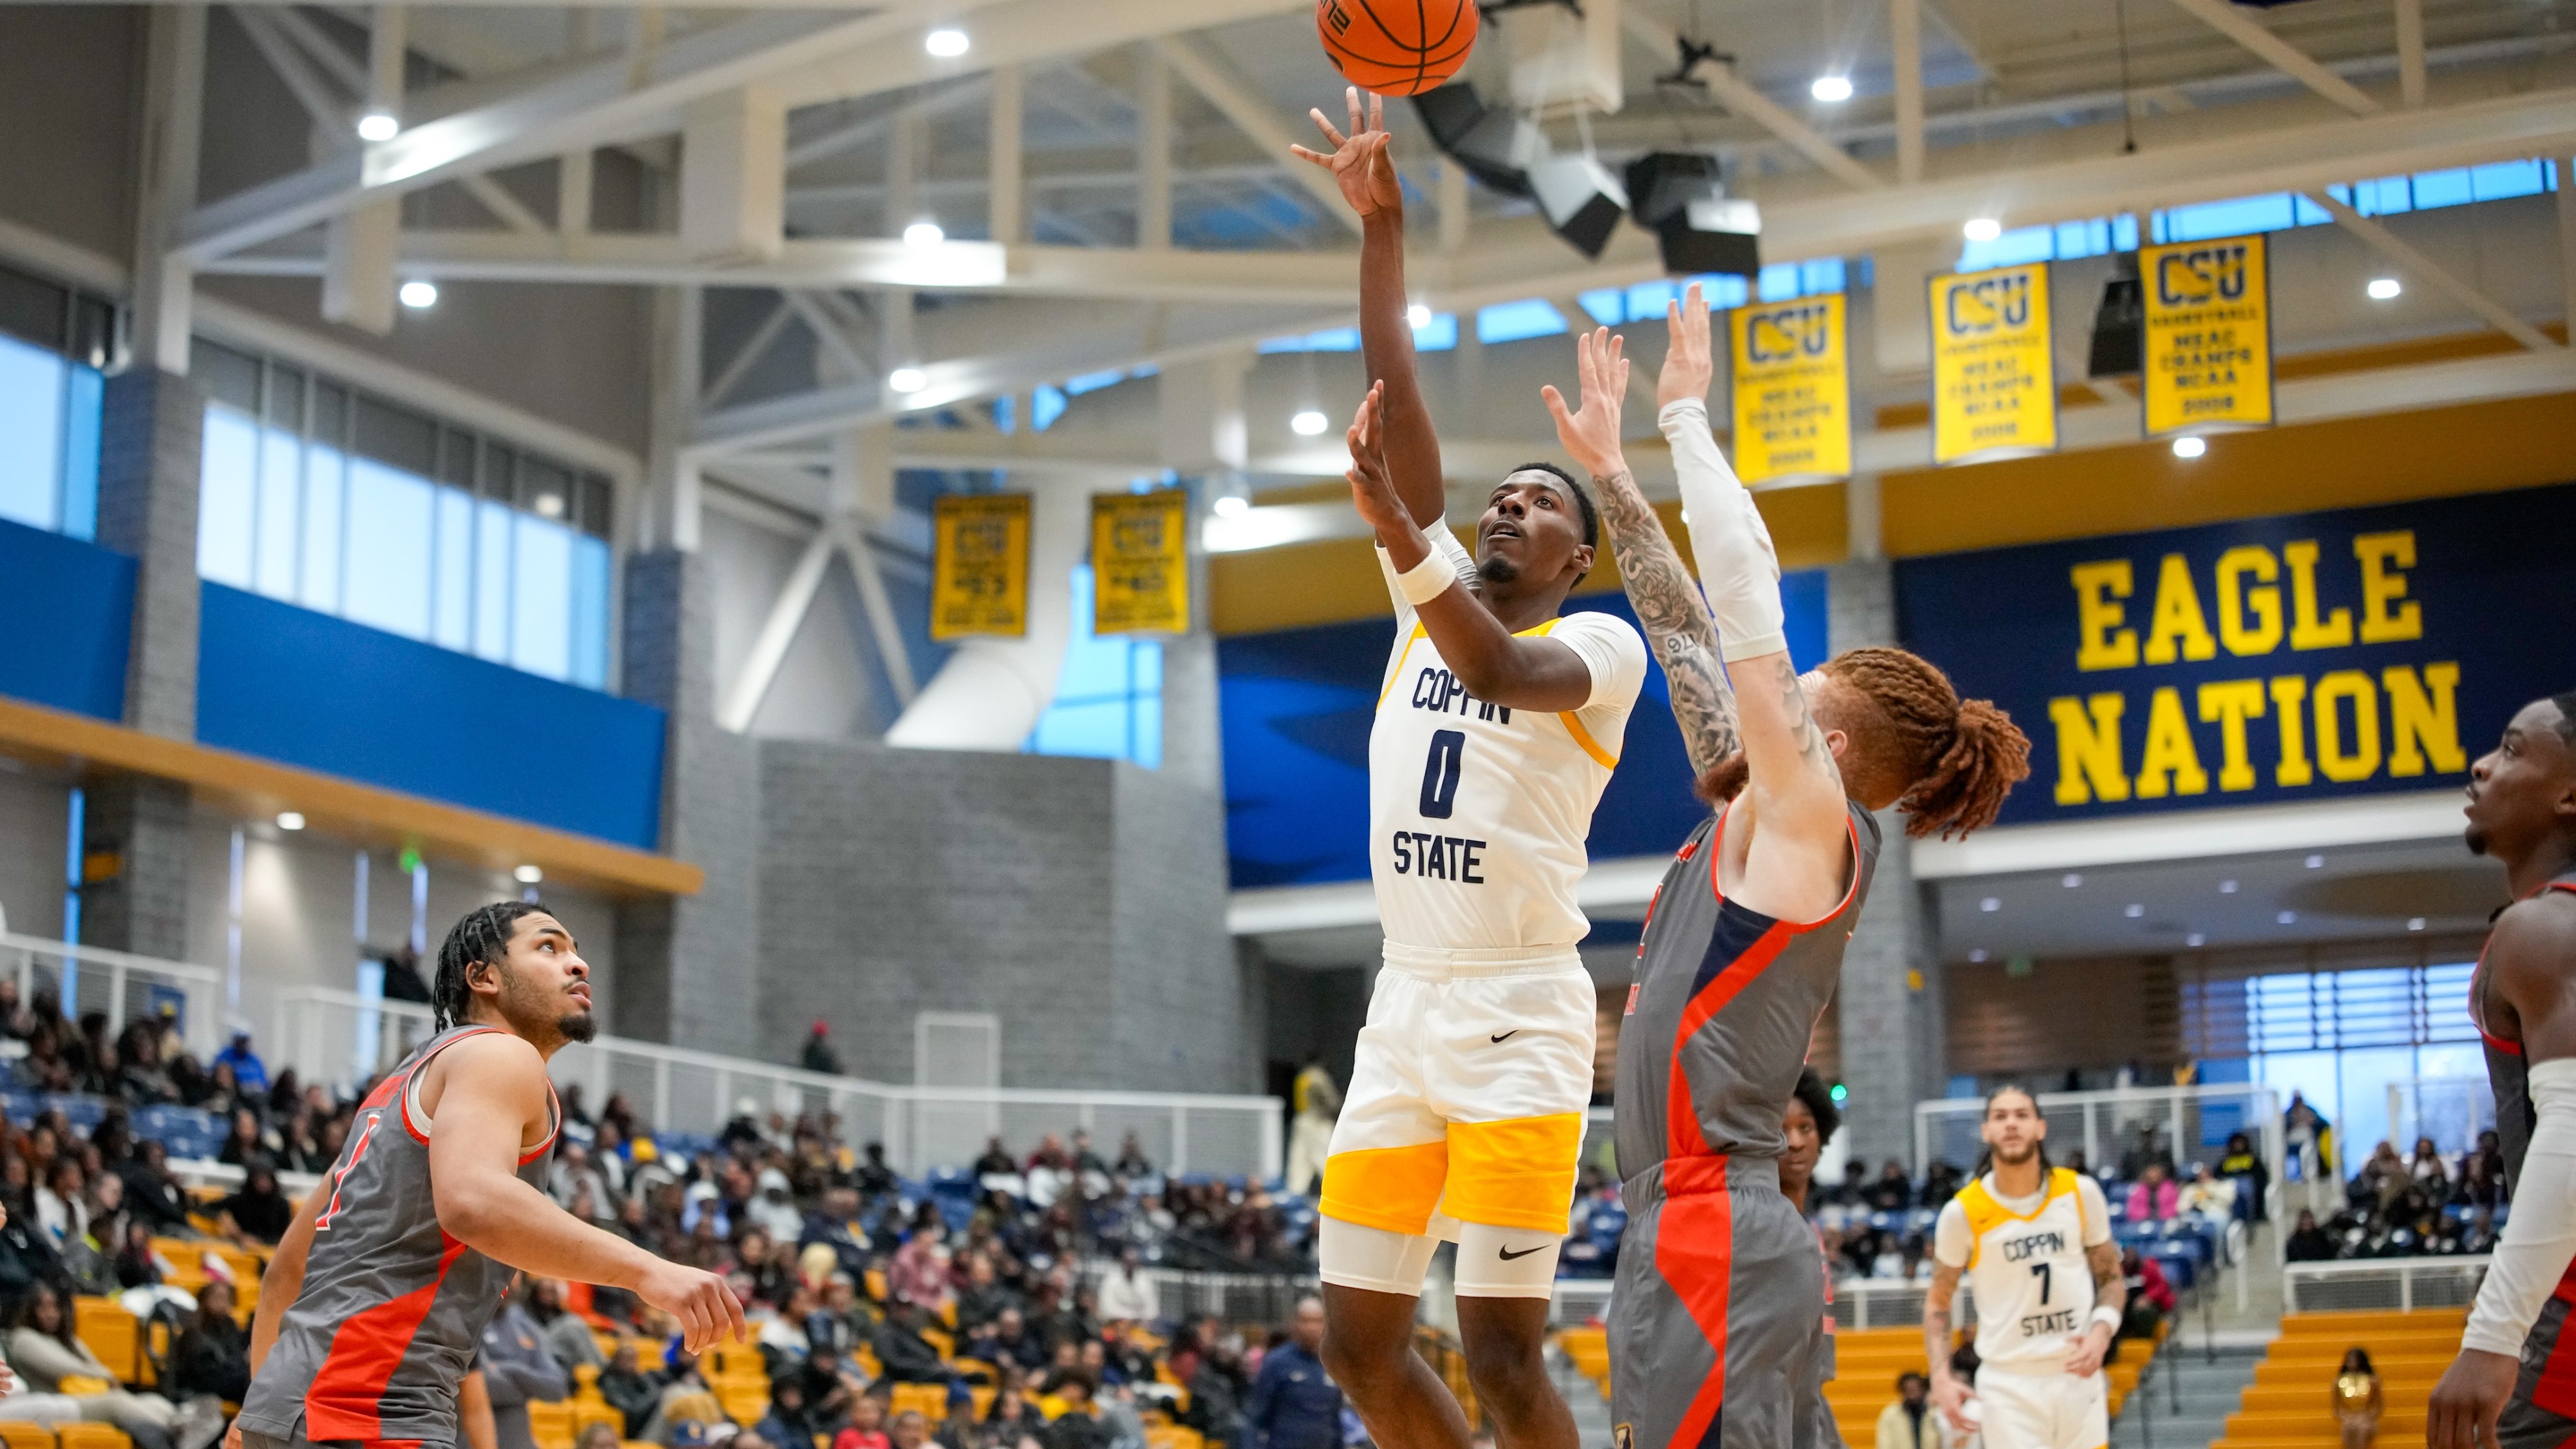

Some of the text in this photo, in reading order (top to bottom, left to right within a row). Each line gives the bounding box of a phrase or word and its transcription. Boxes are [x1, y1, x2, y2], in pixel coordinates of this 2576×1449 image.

[1948, 275, 2028, 334] CSU
[2159, 247, 2245, 305] CSU
[1748, 305, 1826, 363] CSU
[2071, 529, 2423, 671] EAGLE
[2049, 661, 2467, 806] NATION
[1419, 729, 1466, 819] 0
[1394, 831, 1486, 884] STATE
[2003, 1232, 2065, 1262] COPPIN
[2031, 1262, 2051, 1305] 7
[2021, 1309, 2078, 1338] STATE
